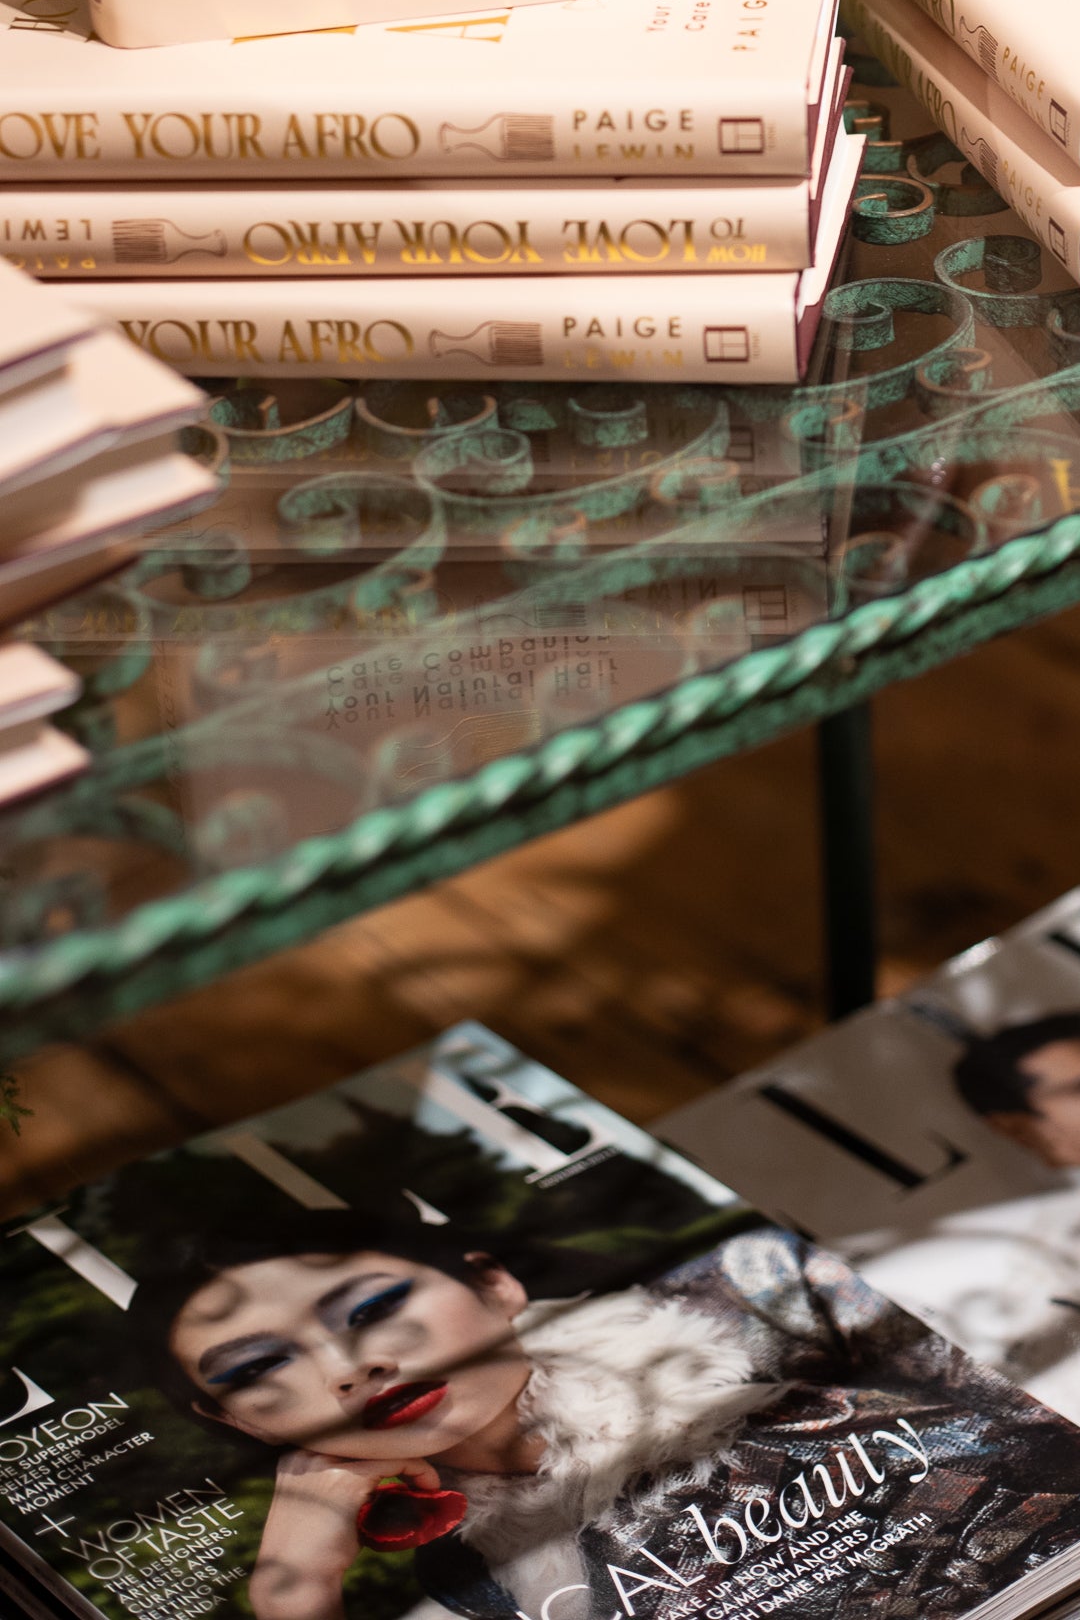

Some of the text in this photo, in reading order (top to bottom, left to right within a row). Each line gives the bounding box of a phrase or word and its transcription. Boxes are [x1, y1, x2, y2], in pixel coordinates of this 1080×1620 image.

[685, 2, 710, 32] Care
[1002, 46, 1045, 100] PAIGE
[0, 112, 420, 160] OVE YOUR AFRO
[572, 109, 695, 131] PAIGE
[572, 144, 695, 160] LEWIN
[1002, 160, 1042, 217] PAIGE
[3, 219, 93, 241] LEWI
[243, 220, 698, 265] LOVE YOUR AFRO
[706, 217, 767, 264] HOW TO
[13, 253, 96, 270] PAIG
[117, 320, 414, 363] YOUR AFRO
[563, 317, 681, 338] PAIGE
[564, 349, 683, 368] LEWIN
[0, 1392, 129, 1462] OYEON
[0, 1417, 125, 1479] HE SUPERMODEL
[0, 1449, 86, 1495] SEIZES HER
[7, 1432, 155, 1505] MAIN CHARACTER
[681, 1417, 934, 1565] beauty
[18, 1472, 95, 1515] MOMENT
[62, 1478, 226, 1561] WOMEN
[88, 1497, 244, 1580] OF TASTE
[103, 1527, 238, 1593] THE DESIGNERS,
[118, 1546, 225, 1605] ARTISTS AND
[212, 1566, 248, 1586] THE
[658, 1510, 867, 1620] AKE-UP NOW AND THE
[705, 1529, 869, 1620] GAME-CHANGERS
[757, 1578, 815, 1613] DAME
[812, 1564, 847, 1584] PAT
[848, 1511, 933, 1567] McGRATH
[127, 1565, 218, 1614] CURATORS
